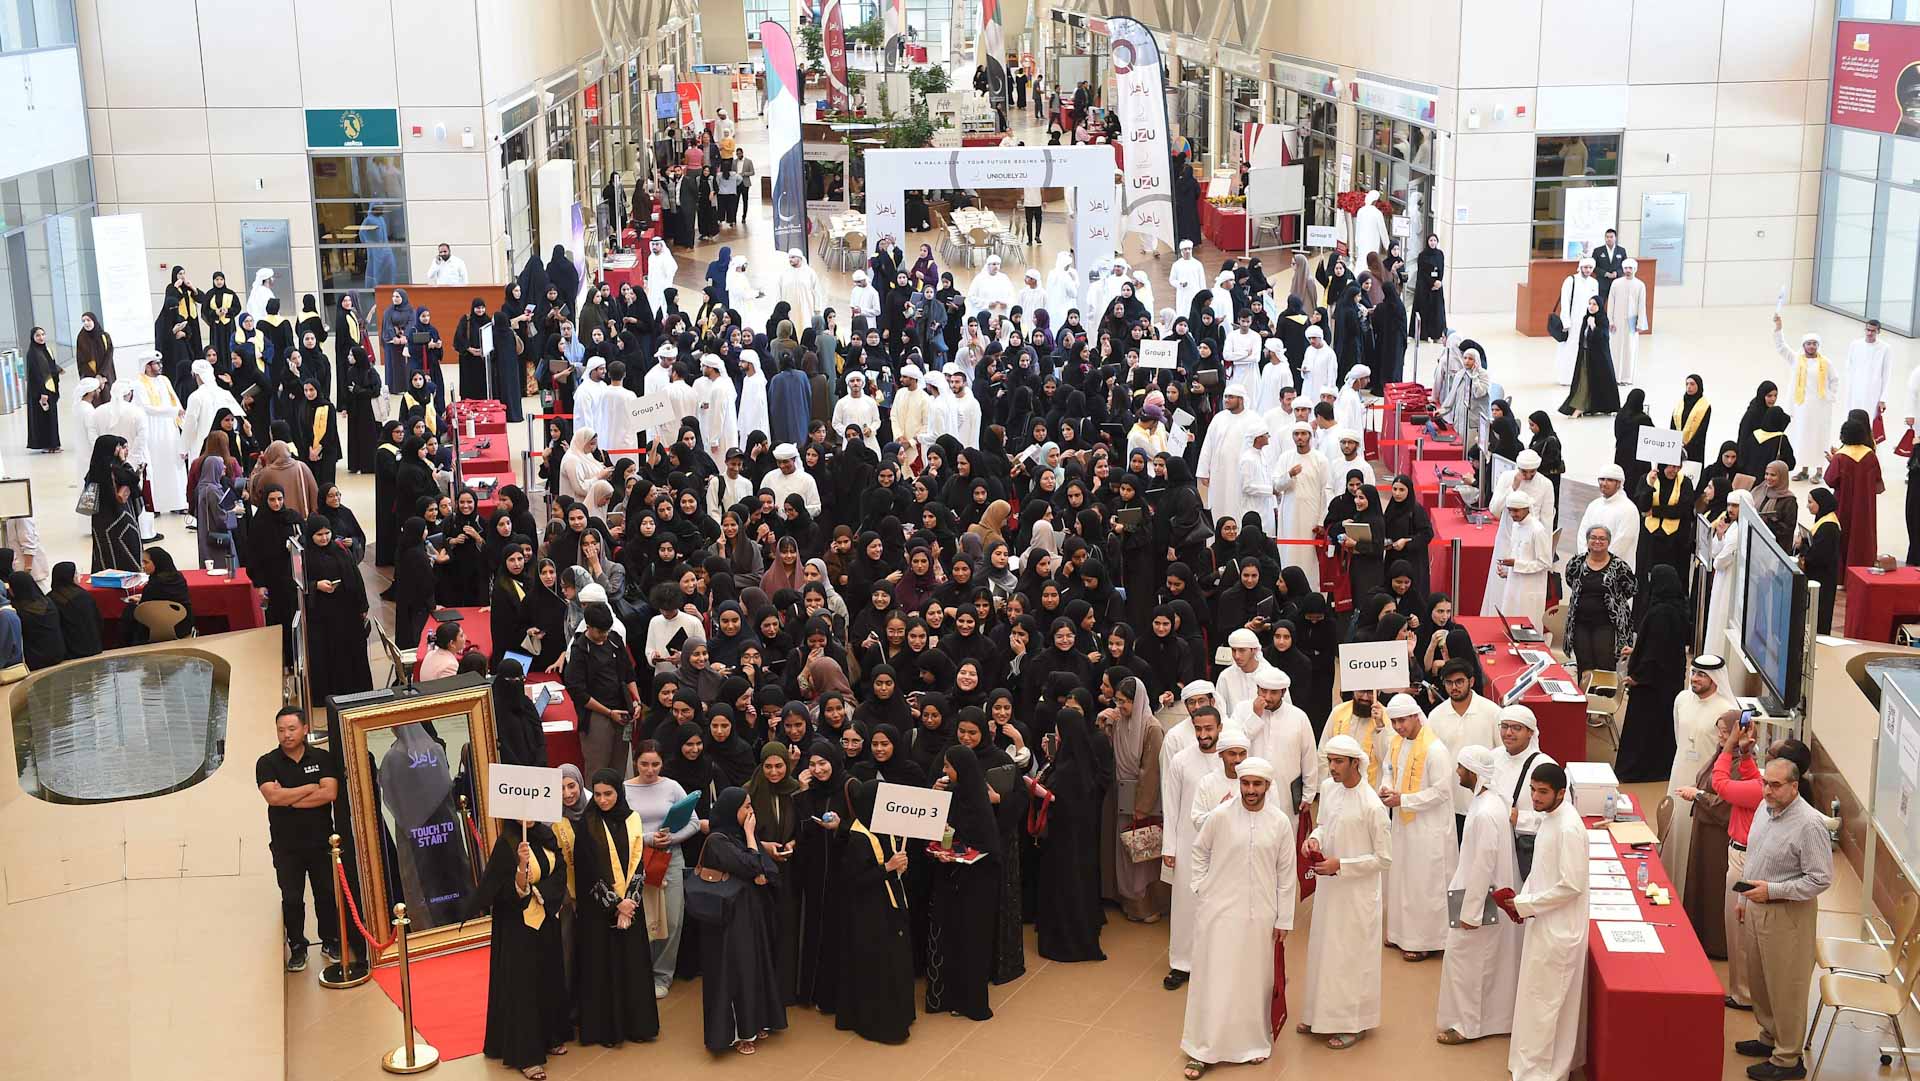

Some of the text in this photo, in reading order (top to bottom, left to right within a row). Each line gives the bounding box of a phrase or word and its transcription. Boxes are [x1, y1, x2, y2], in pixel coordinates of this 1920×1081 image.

[1131, 128, 1155, 142] UZU
[1133, 175, 1159, 189] UZU
[1145, 349, 1166, 357] Group
[632, 402, 664, 417] Group 14
[1643, 437, 1676, 449] Group 17
[1349, 657, 1398, 671] Group 5
[498, 783, 551, 799] Group 2
[886, 801, 938, 818] Group 3
[411, 821, 454, 839] TOUCH TO
[418, 832, 449, 848] START
